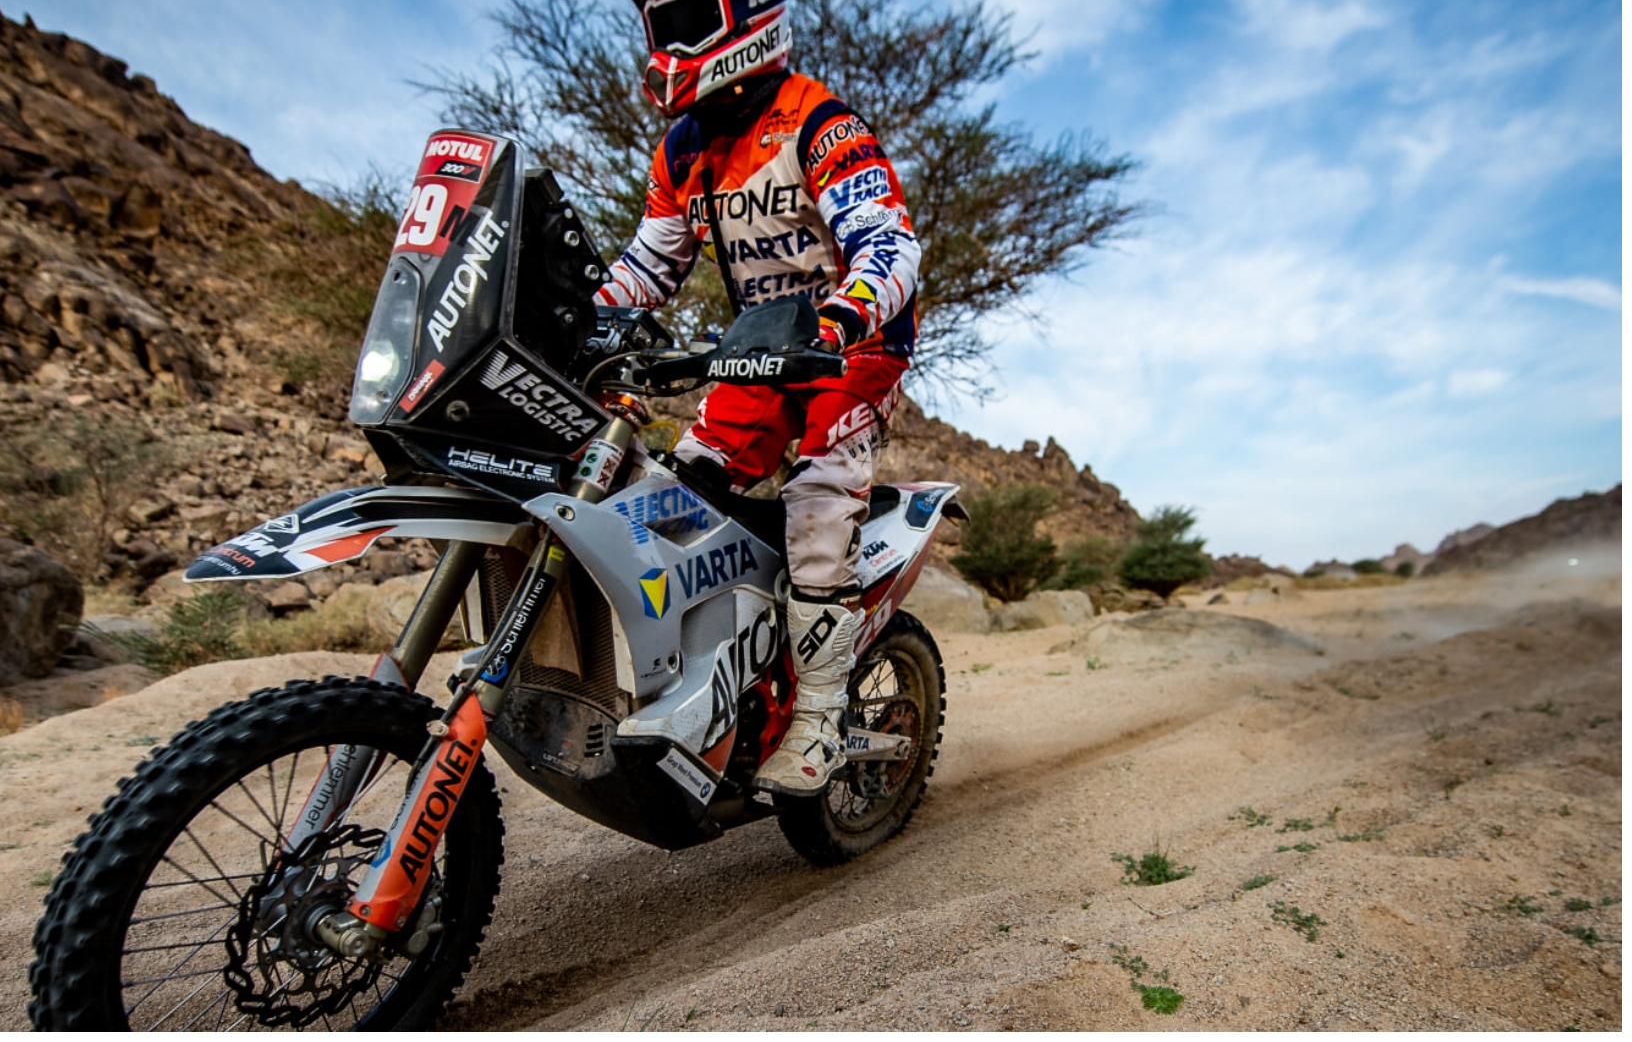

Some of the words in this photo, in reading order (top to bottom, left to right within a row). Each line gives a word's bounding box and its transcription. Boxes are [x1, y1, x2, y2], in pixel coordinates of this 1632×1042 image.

[710, 24, 781, 82] AUTONET
[426, 139, 484, 162] MOTUL
[426, 210, 506, 353] AUTONET
[479, 349, 600, 434] VECTRA
[707, 354, 785, 379] AUTONET
[497, 385, 583, 442] LOGISTIC
[447, 445, 553, 477] HELITE
[448, 458, 479, 473] AIRBAG
[479, 463, 525, 479] ELECTRONIC
[526, 472, 556, 484] SYSTEM
[675, 538, 760, 600] VARTA
